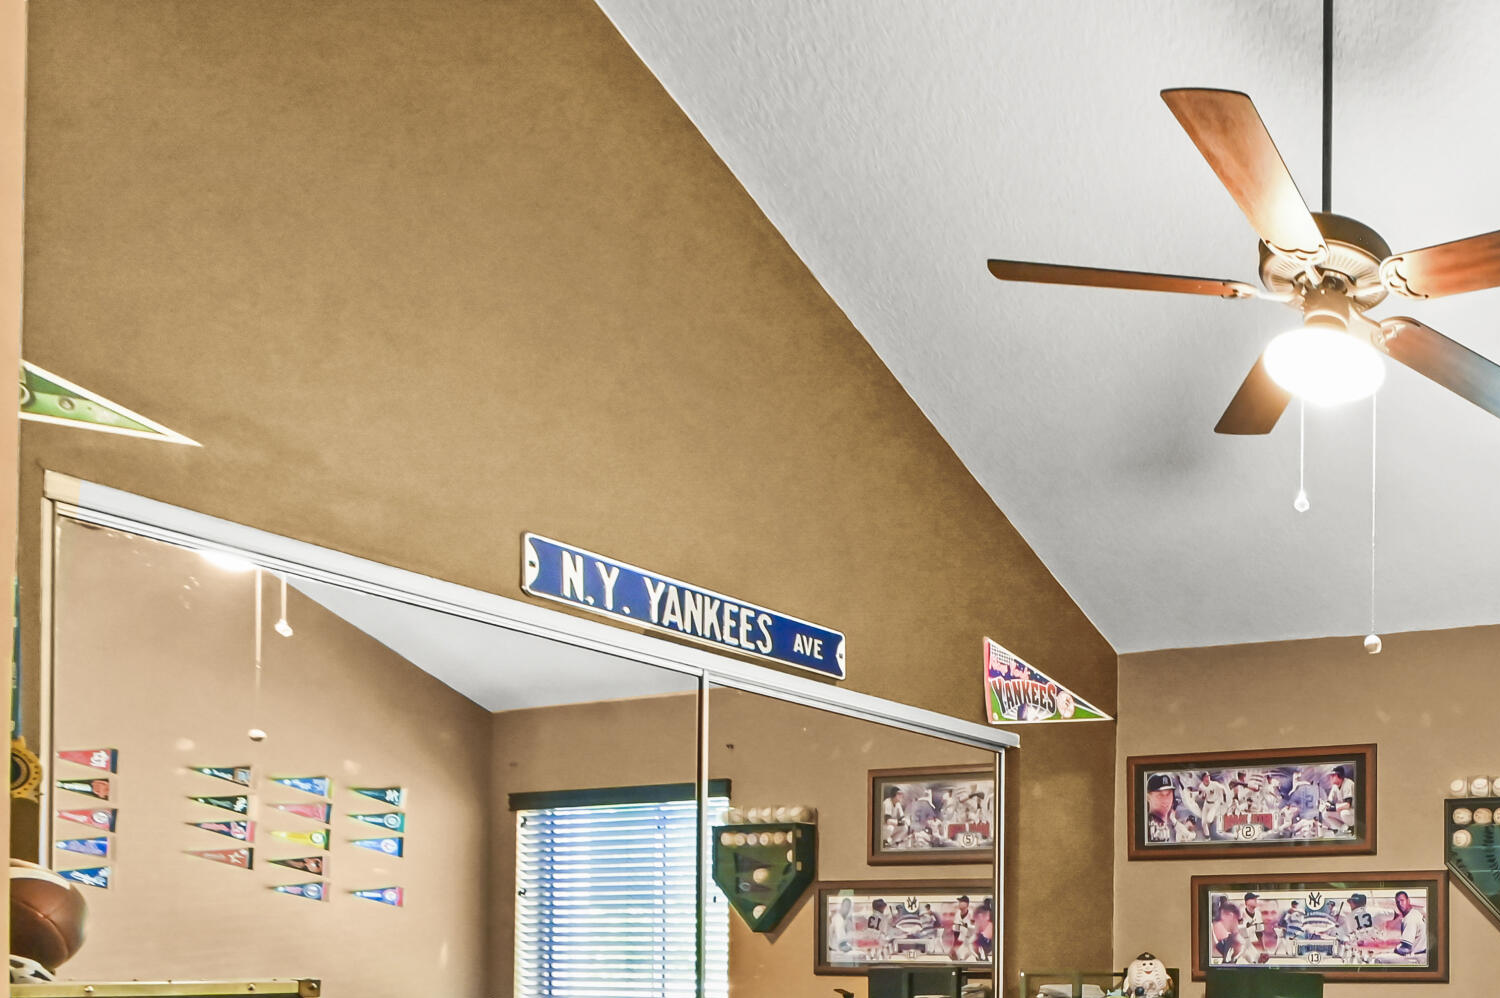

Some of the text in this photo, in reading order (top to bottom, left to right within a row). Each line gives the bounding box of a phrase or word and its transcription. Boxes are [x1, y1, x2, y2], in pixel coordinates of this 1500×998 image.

[561, 550, 824, 661] N.Y. YANKEES AVE
[991, 677, 1058, 715] YANKEES
[1354, 912, 1373, 931] 13
[1310, 953, 1319, 963] 13
